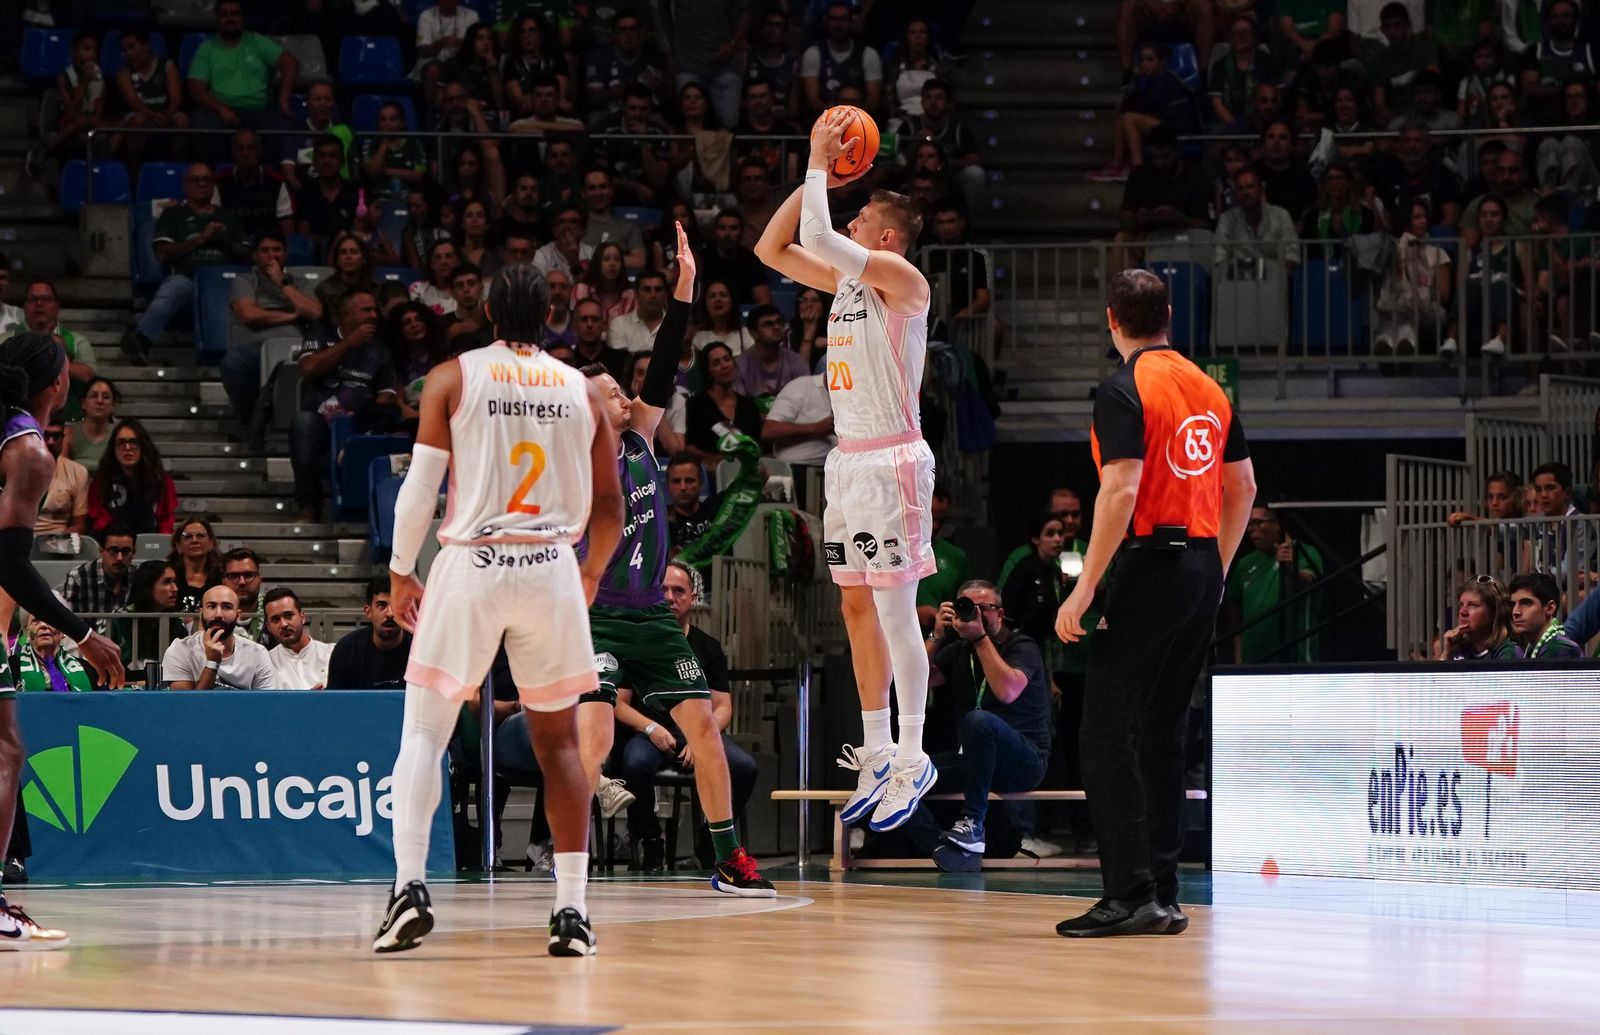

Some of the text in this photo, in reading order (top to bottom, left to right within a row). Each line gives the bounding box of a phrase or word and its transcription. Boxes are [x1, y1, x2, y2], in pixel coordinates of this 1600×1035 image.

[488, 362, 566, 388] WALDEN
[828, 360, 853, 391] 20
[1184, 428, 1213, 462] 63
[506, 440, 546, 516] 2
[497, 548, 559, 567] serveto
[629, 541, 644, 570] 4
[1367, 742, 1463, 839] enPie.es
